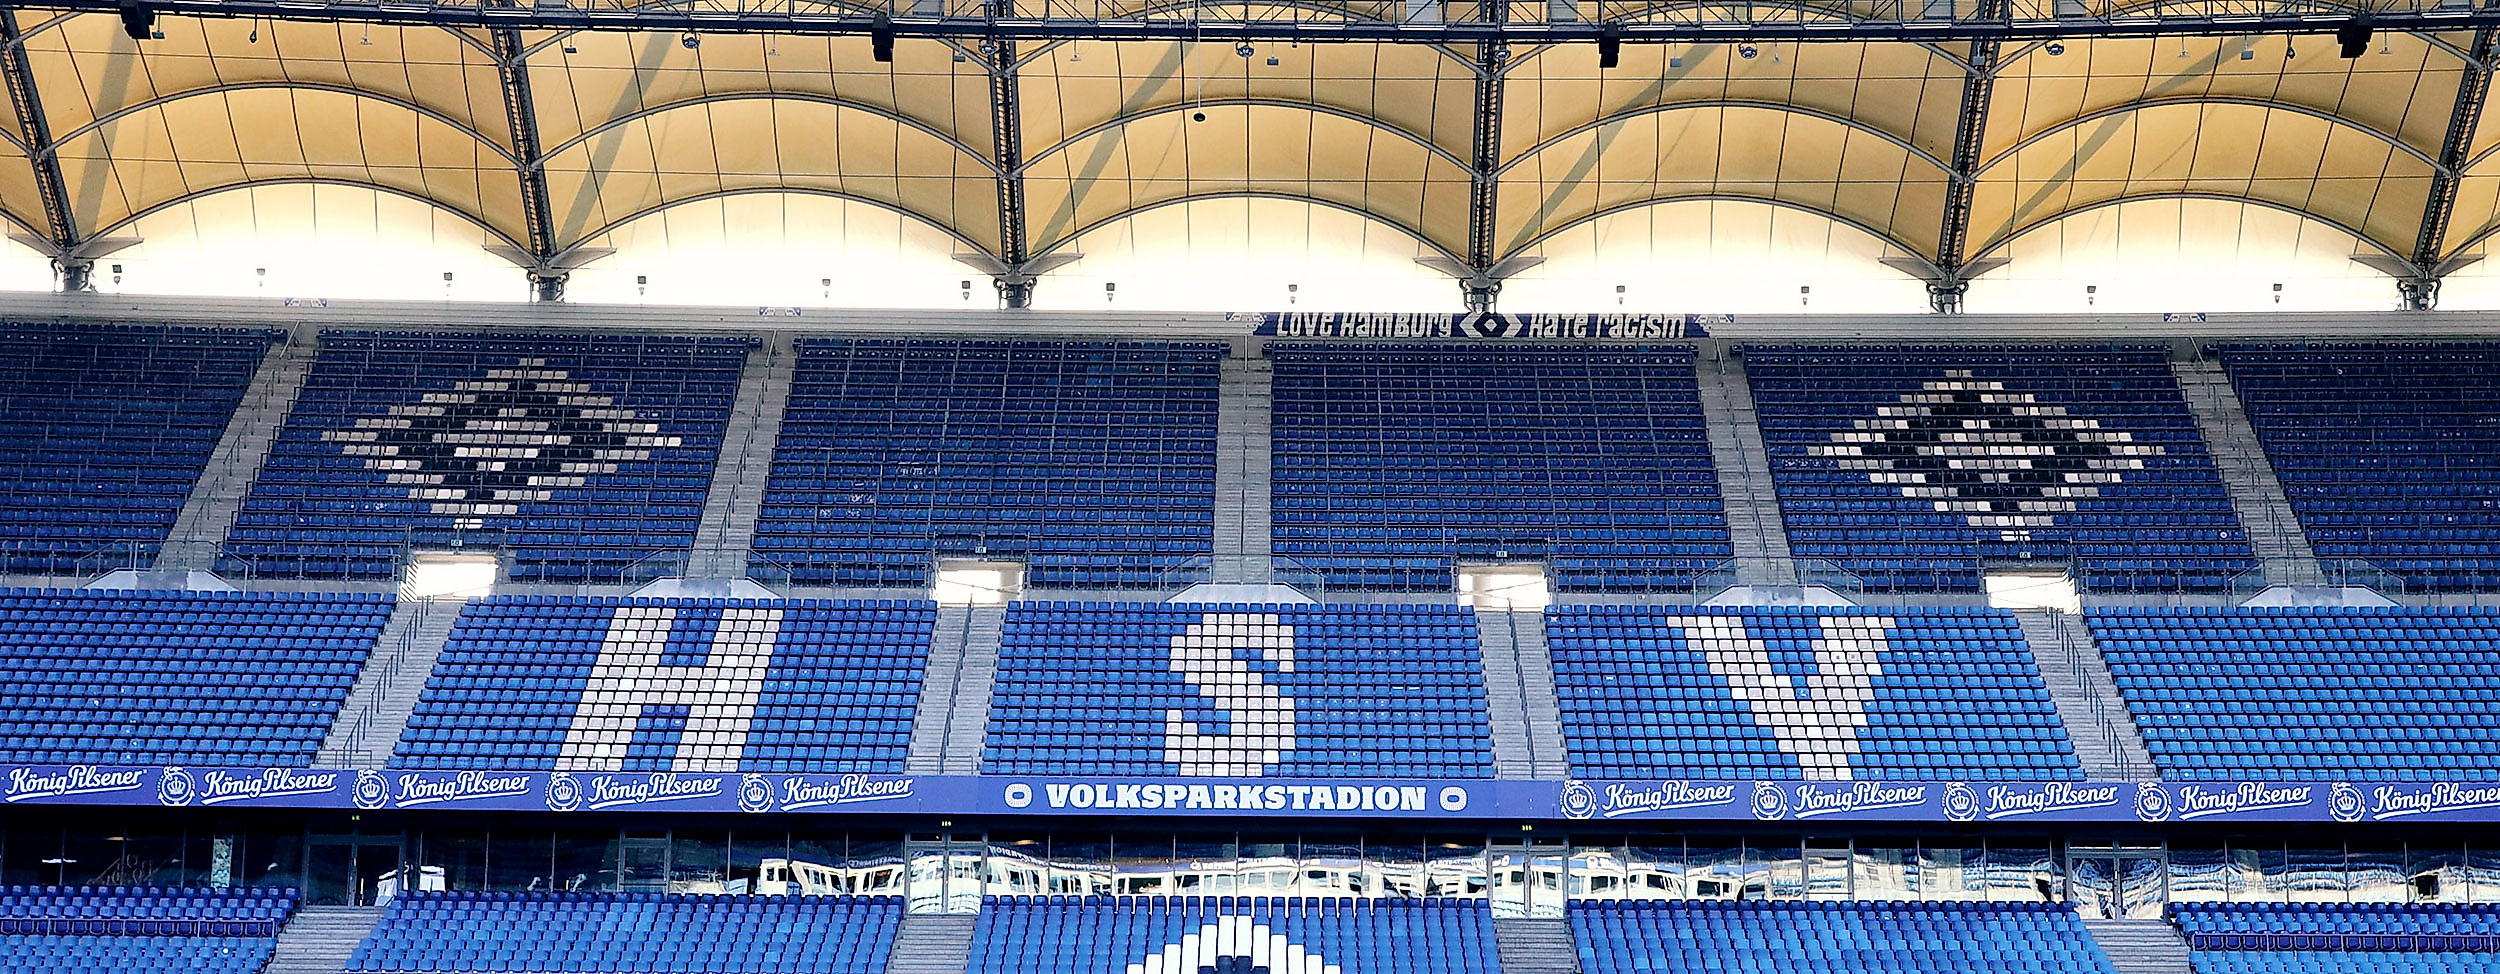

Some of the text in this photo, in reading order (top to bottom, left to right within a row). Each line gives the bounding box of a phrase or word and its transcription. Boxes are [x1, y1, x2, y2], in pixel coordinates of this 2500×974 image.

[554, 607, 1896, 780] H S V
[1046, 783, 1427, 811] VOLKSPARKSTADION
